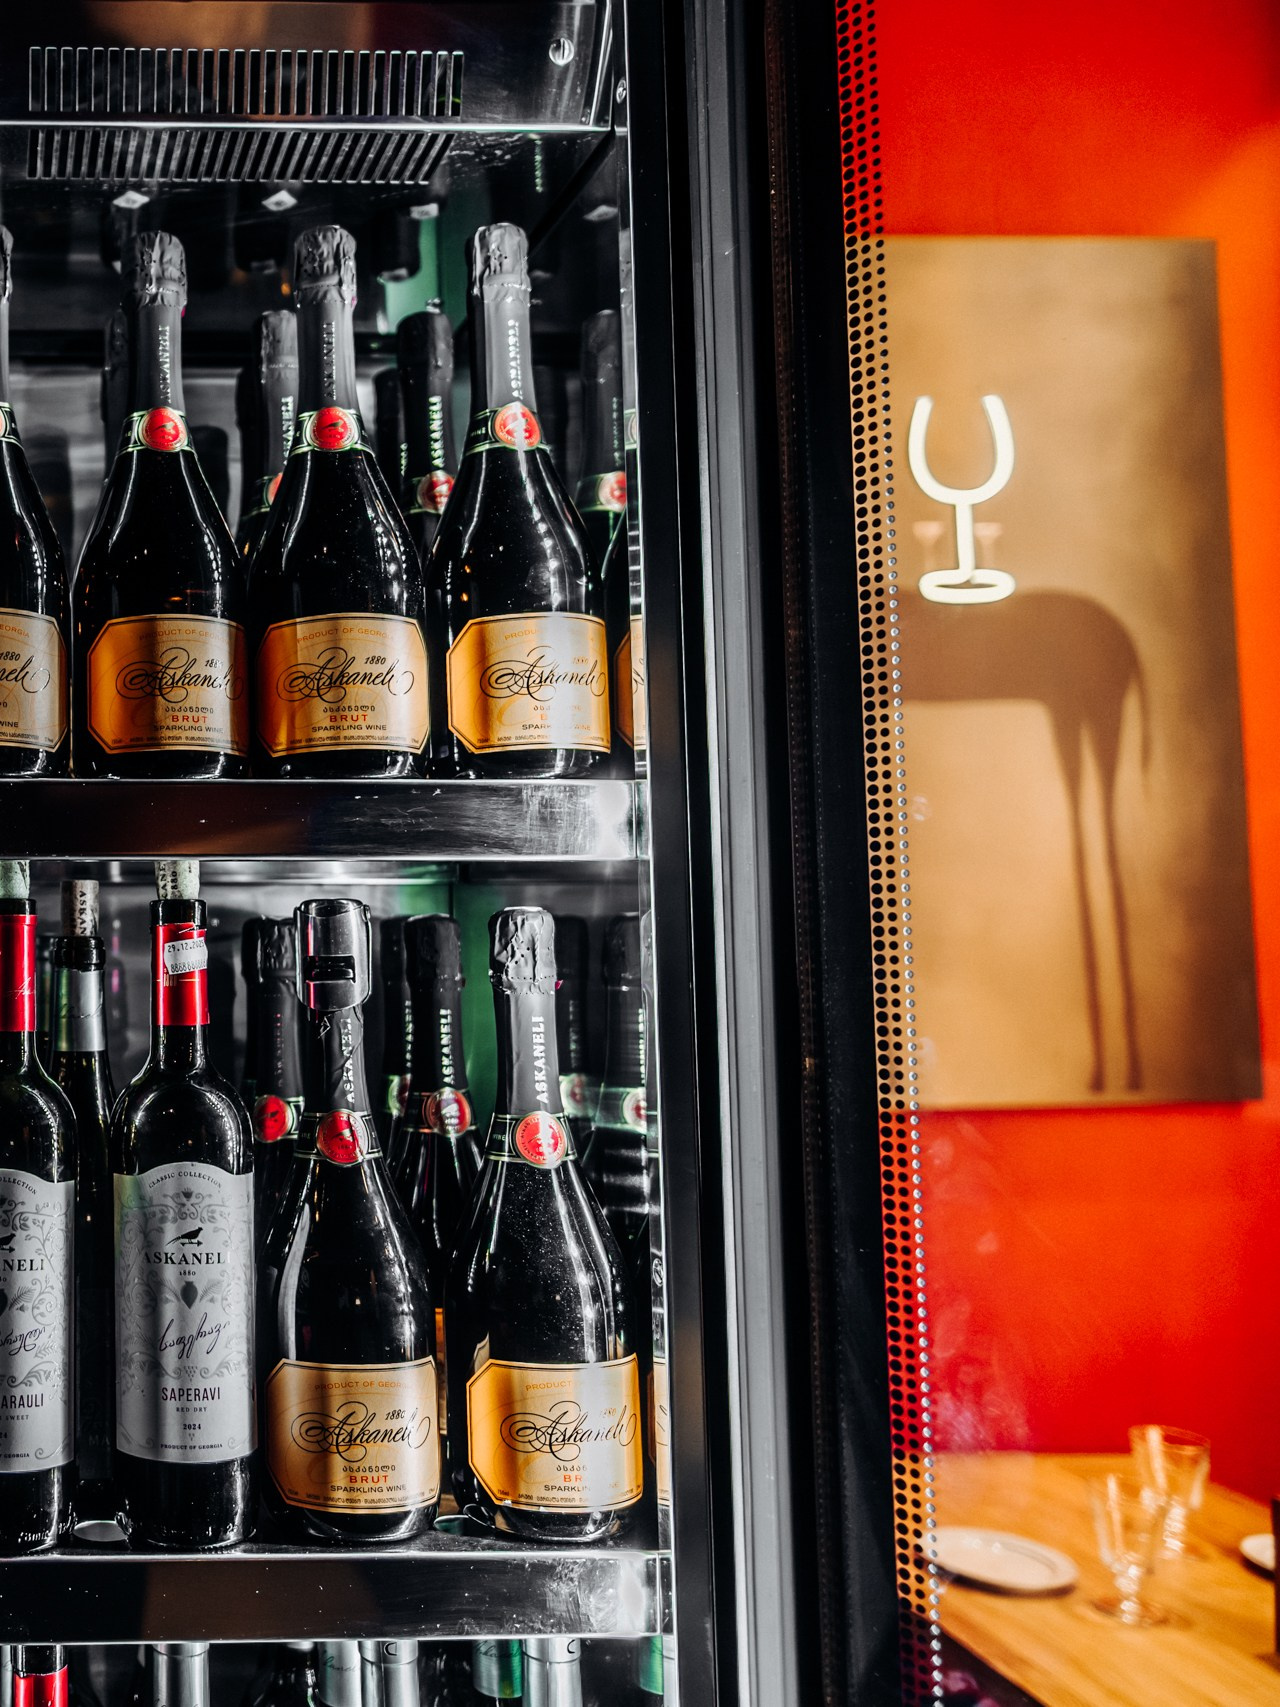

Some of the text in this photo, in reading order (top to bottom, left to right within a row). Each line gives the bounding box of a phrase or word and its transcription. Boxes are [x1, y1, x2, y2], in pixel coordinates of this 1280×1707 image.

[297, 628, 340, 644] PRODUCT
[364, 656, 387, 665] 1880
[171, 715, 208, 724] BRUT
[329, 714, 368, 723] BRUT
[311, 724, 363, 732] SPARKLING
[439, 1008, 455, 1085] ASKANELI
[531, 1016, 548, 1104] ASKANELI
[148, 1170, 222, 1189] CLASSIC COLLECTION
[314, 1381, 359, 1391] PRODUCT
[161, 1386, 221, 1402] SAPERAVI
[349, 1475, 389, 1484] BRUT
[330, 1484, 407, 1493] SPARKLING WINE
[543, 1484, 590, 1492] SPARKLIN
